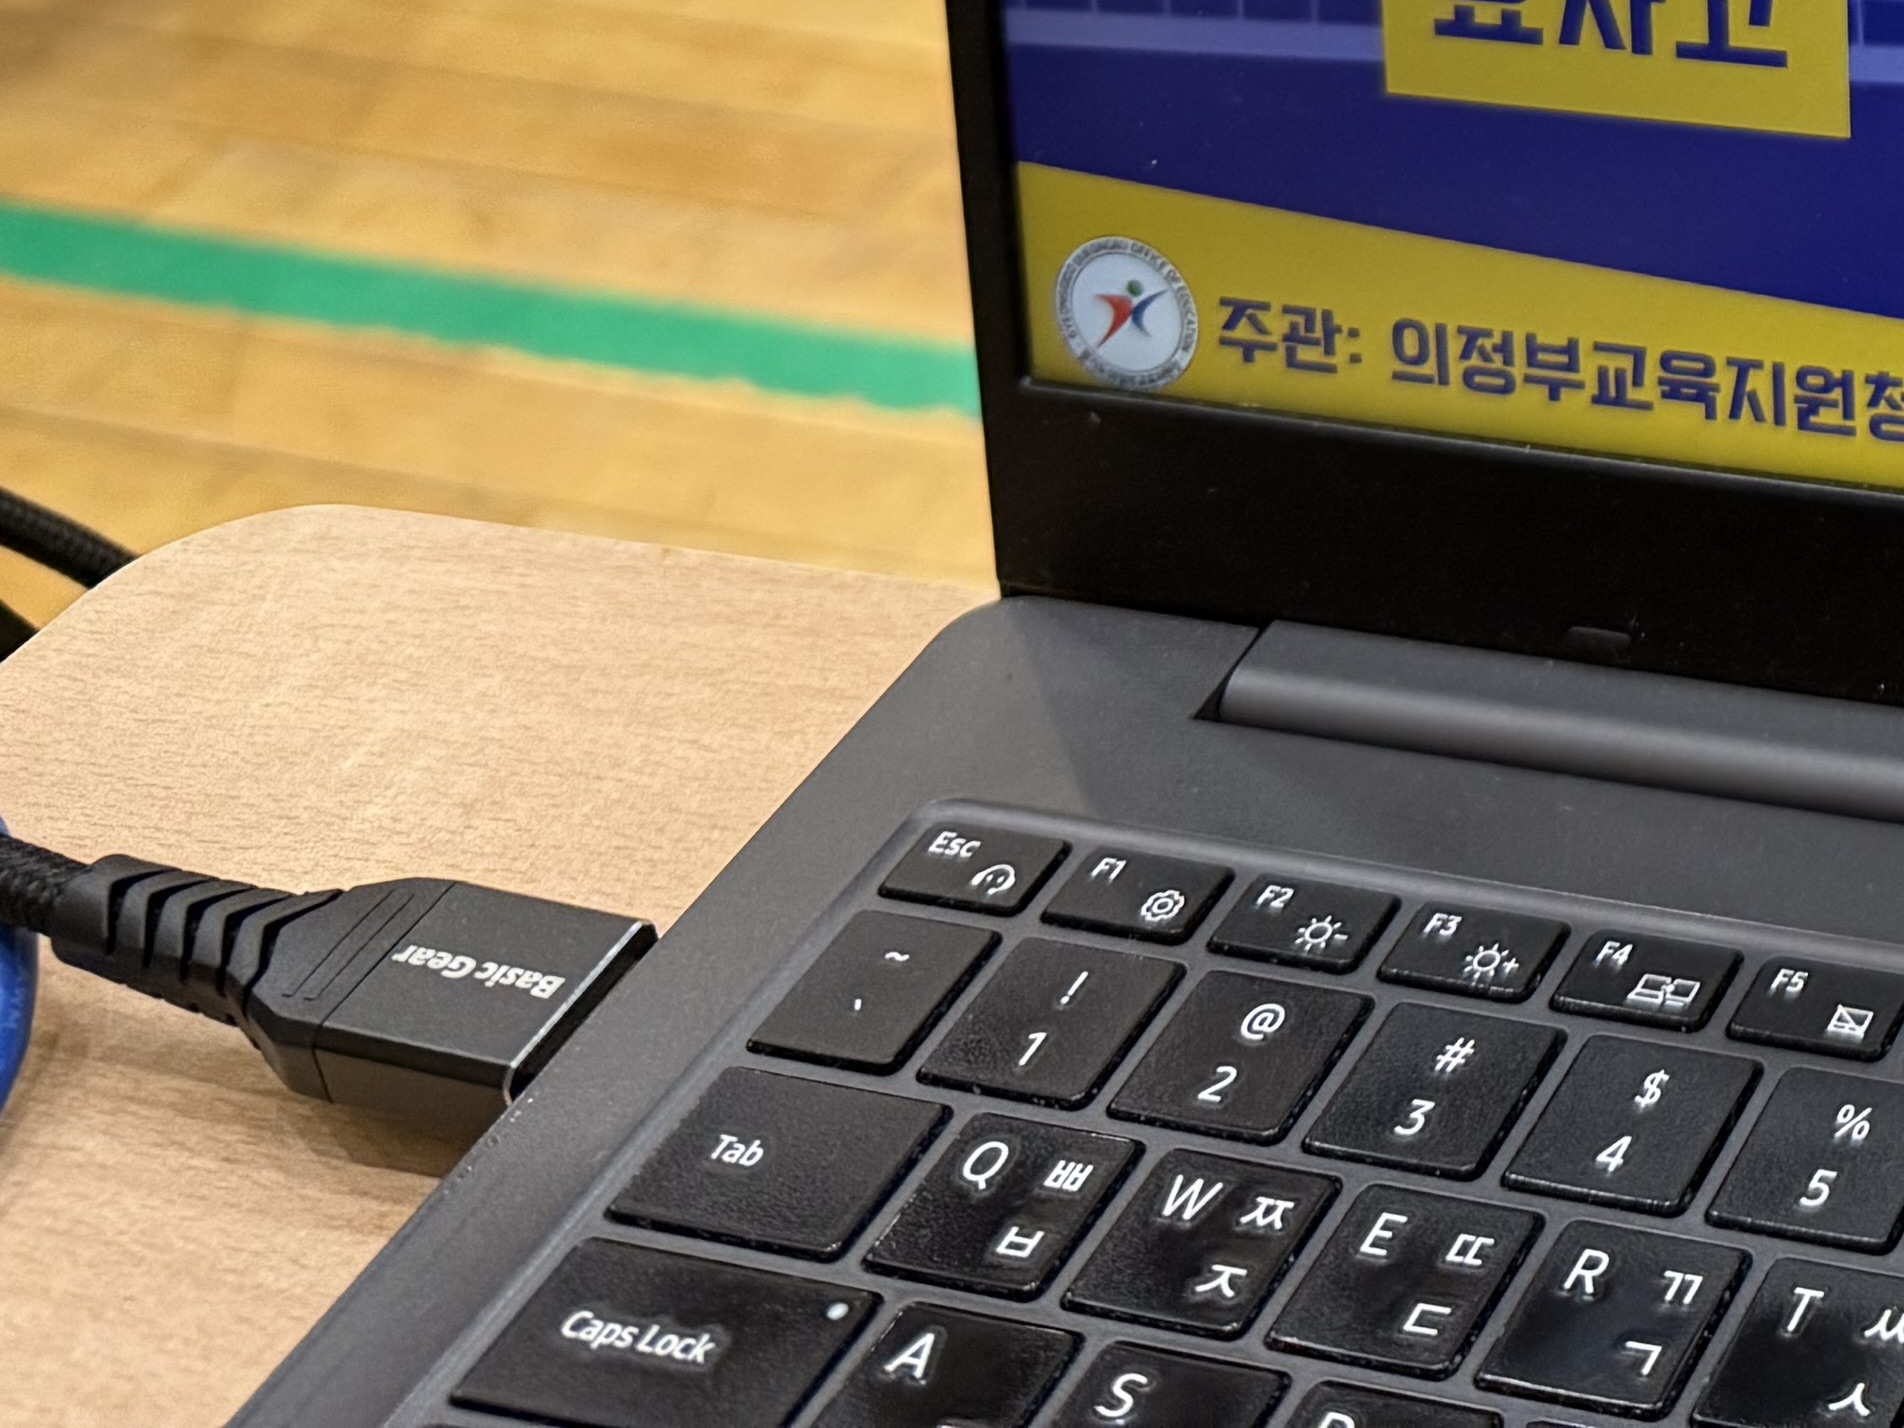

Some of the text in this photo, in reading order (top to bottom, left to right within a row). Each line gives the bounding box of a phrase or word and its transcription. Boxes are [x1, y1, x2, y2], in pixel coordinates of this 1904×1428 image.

[1218, 297, 1361, 374] 주관:
[929, 832, 980, 857] Esc
[1092, 858, 1126, 880] F1
[1257, 885, 1293, 908] F2
[1424, 913, 1461, 936] F3
[391, 945, 565, 999] Basic Gear
[1597, 942, 1632, 966] F4
[1061, 972, 1088, 1004] !
[1771, 969, 1808, 993] F5
[1241, 1004, 1285, 1040] @
[1019, 1033, 1046, 1065] 1
[1435, 1038, 1474, 1072] #
[1198, 1066, 1237, 1102] 2
[1635, 1070, 1669, 1108] $
[1395, 1099, 1435, 1135] 3
[1835, 1105, 1872, 1140] %
[711, 1135, 763, 1166] Tab
[963, 1142, 1008, 1189] Q
[1596, 1136, 1631, 1172] 4
[1163, 1175, 1223, 1220] W
[1800, 1169, 1837, 1207] 5
[1360, 1213, 1407, 1255] E
[1564, 1249, 1609, 1293] R
[1787, 1287, 1824, 1331] T
[562, 1311, 714, 1363] Caps Lock
[885, 1333, 934, 1378] A
[1095, 1373, 1147, 1417] S
